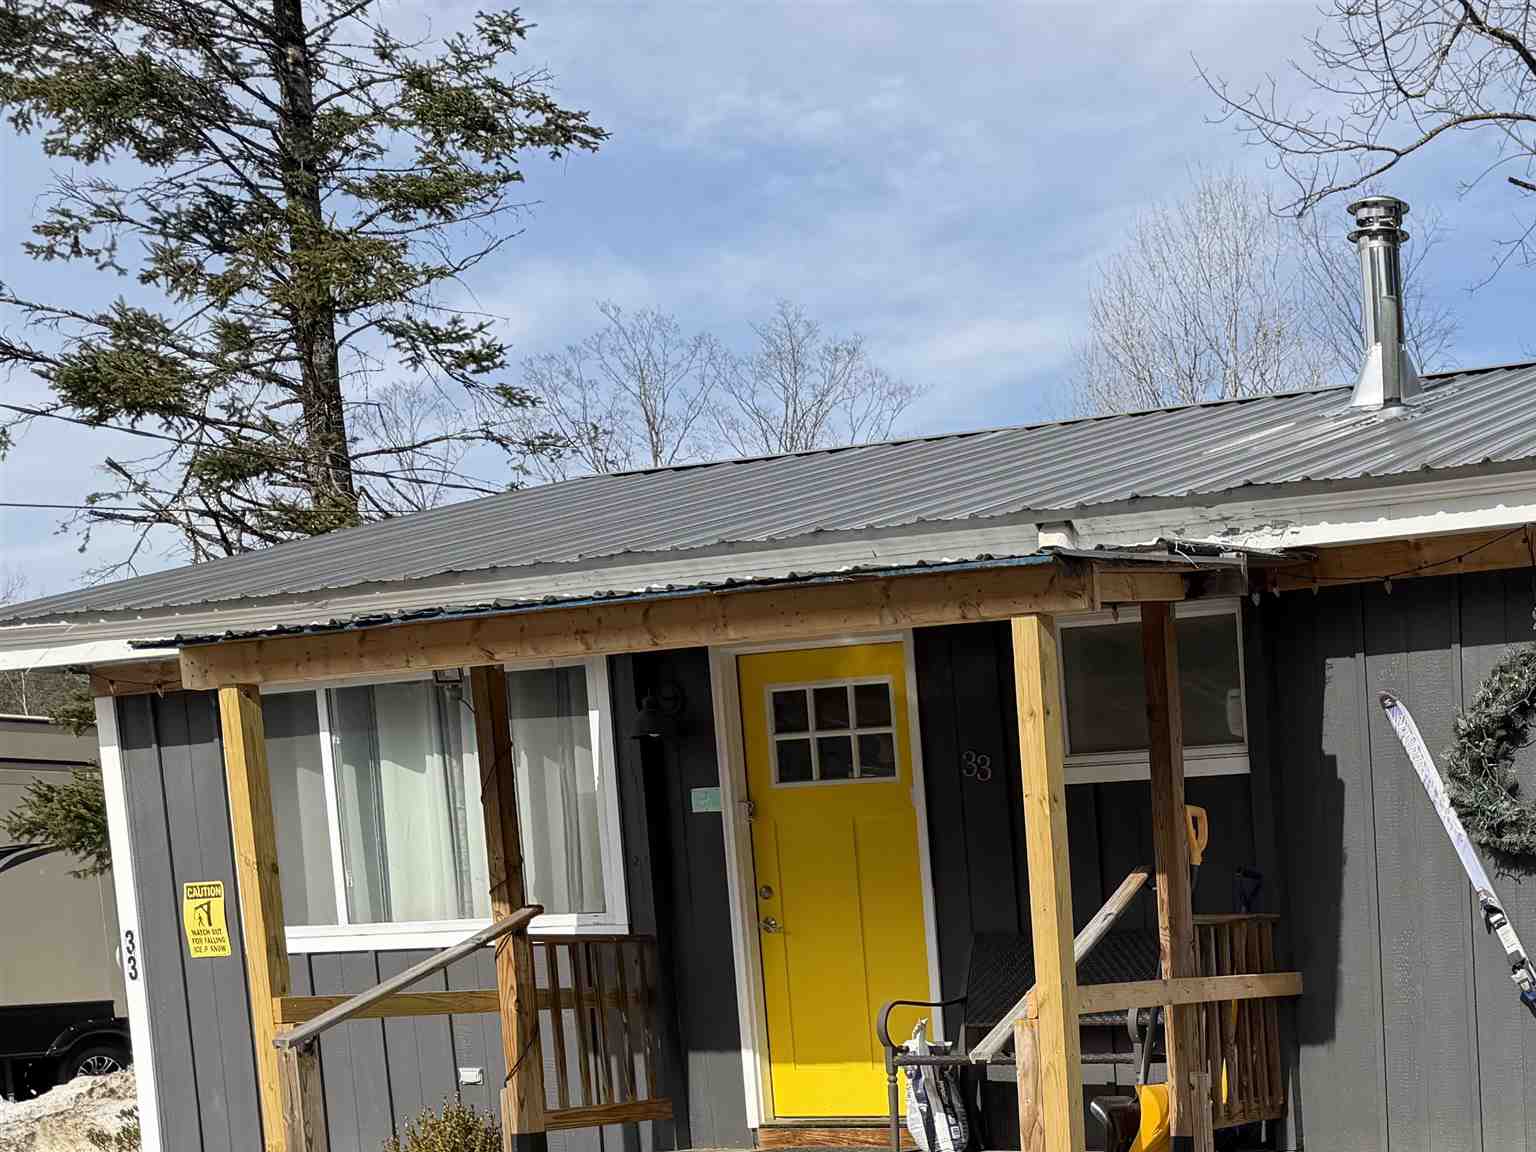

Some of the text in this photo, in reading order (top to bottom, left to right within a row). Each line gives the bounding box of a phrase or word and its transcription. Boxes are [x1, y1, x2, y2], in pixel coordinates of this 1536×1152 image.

[961, 750, 992, 782] 33
[187, 886, 222, 898] CAUTION
[191, 928, 210, 936] WATCH
[125, 930, 139, 981] 33
